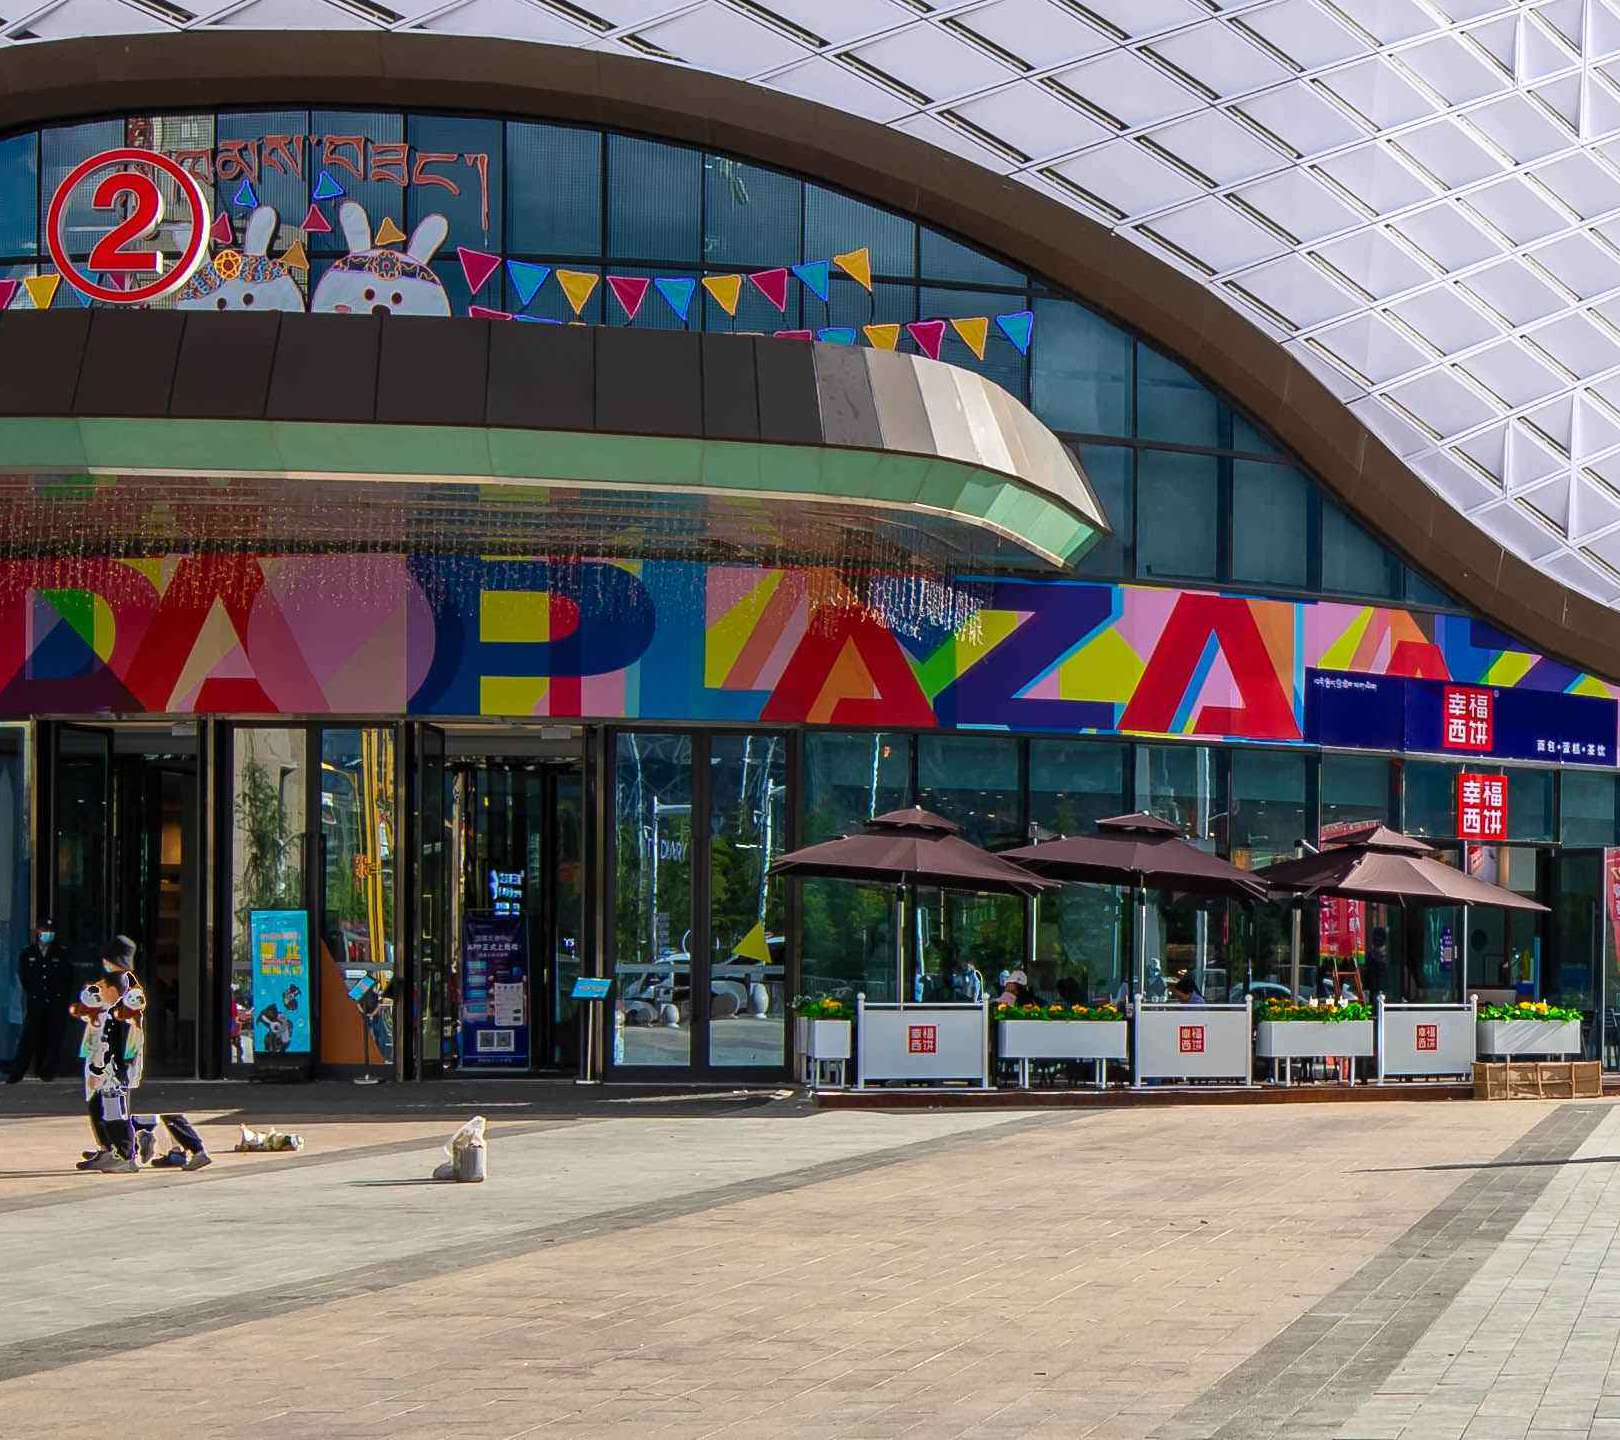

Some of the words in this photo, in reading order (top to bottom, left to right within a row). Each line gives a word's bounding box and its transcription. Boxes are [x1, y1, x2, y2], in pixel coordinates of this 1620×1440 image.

[408, 555, 1305, 739] PLAZA
[1448, 692, 1489, 719] 幸福
[1448, 719, 1489, 745] 西饼
[1462, 781, 1502, 807] 幸福
[1462, 807, 1502, 834] 西饼
